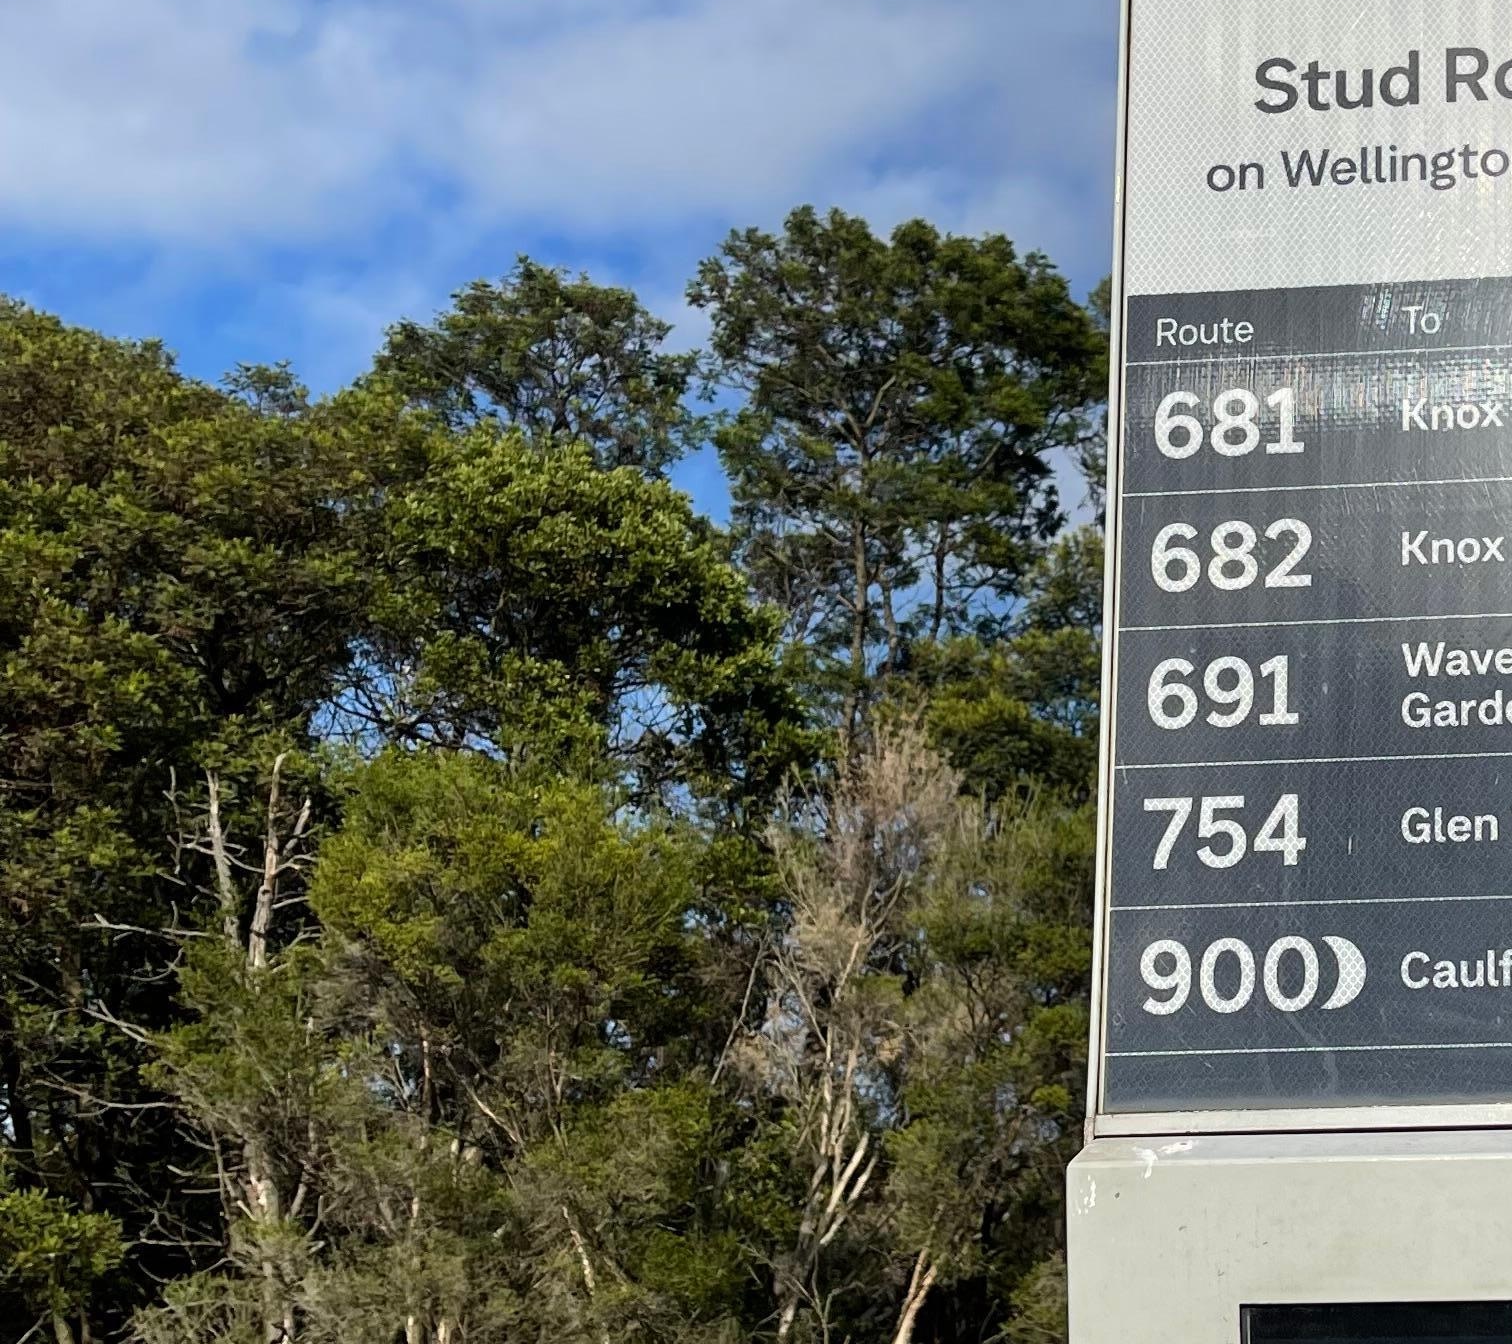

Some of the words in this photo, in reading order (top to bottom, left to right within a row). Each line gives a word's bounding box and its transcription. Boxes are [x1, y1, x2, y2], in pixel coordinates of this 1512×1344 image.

[1254, 49, 1420, 114] Stud
[1206, 161, 1264, 192] on
[1155, 317, 1254, 346] Route
[1404, 305, 1441, 335] To
[1153, 388, 1305, 459] 681
[1401, 395, 1503, 432] Knox
[1150, 519, 1313, 594] 682
[1401, 530, 1504, 567] Knox
[1148, 655, 1299, 730] 691
[1143, 794, 1306, 871] 754
[1400, 807, 1497, 845] Glen
[1140, 936, 1321, 1015] 900
